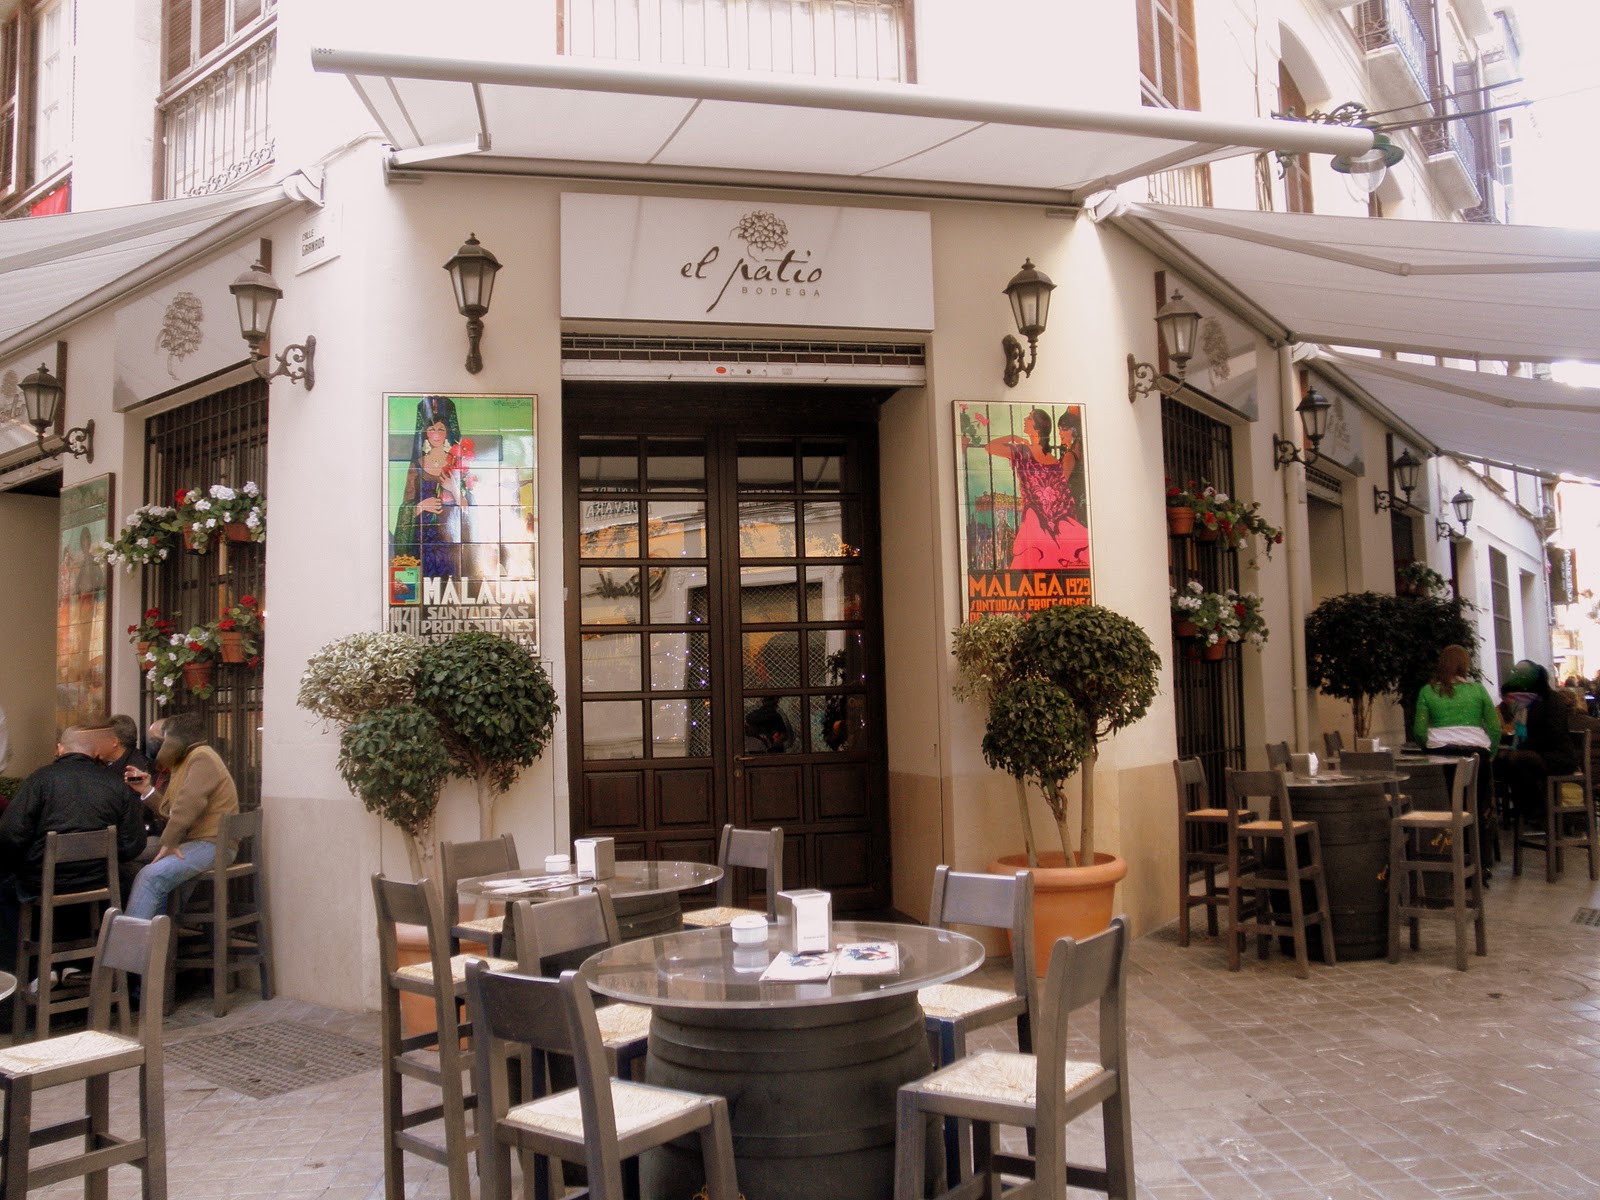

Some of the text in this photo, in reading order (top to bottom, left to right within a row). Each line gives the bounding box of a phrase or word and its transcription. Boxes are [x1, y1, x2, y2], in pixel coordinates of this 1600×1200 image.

[681, 246, 822, 312] el patio
[742, 286, 820, 297] BODEGA
[1065, 578, 1091, 595] 1929
[970, 599, 1025, 611] SUNTUOSAS
[427, 606, 529, 620] SUNTUOSAS
[421, 620, 534, 634] PROCESIONES
